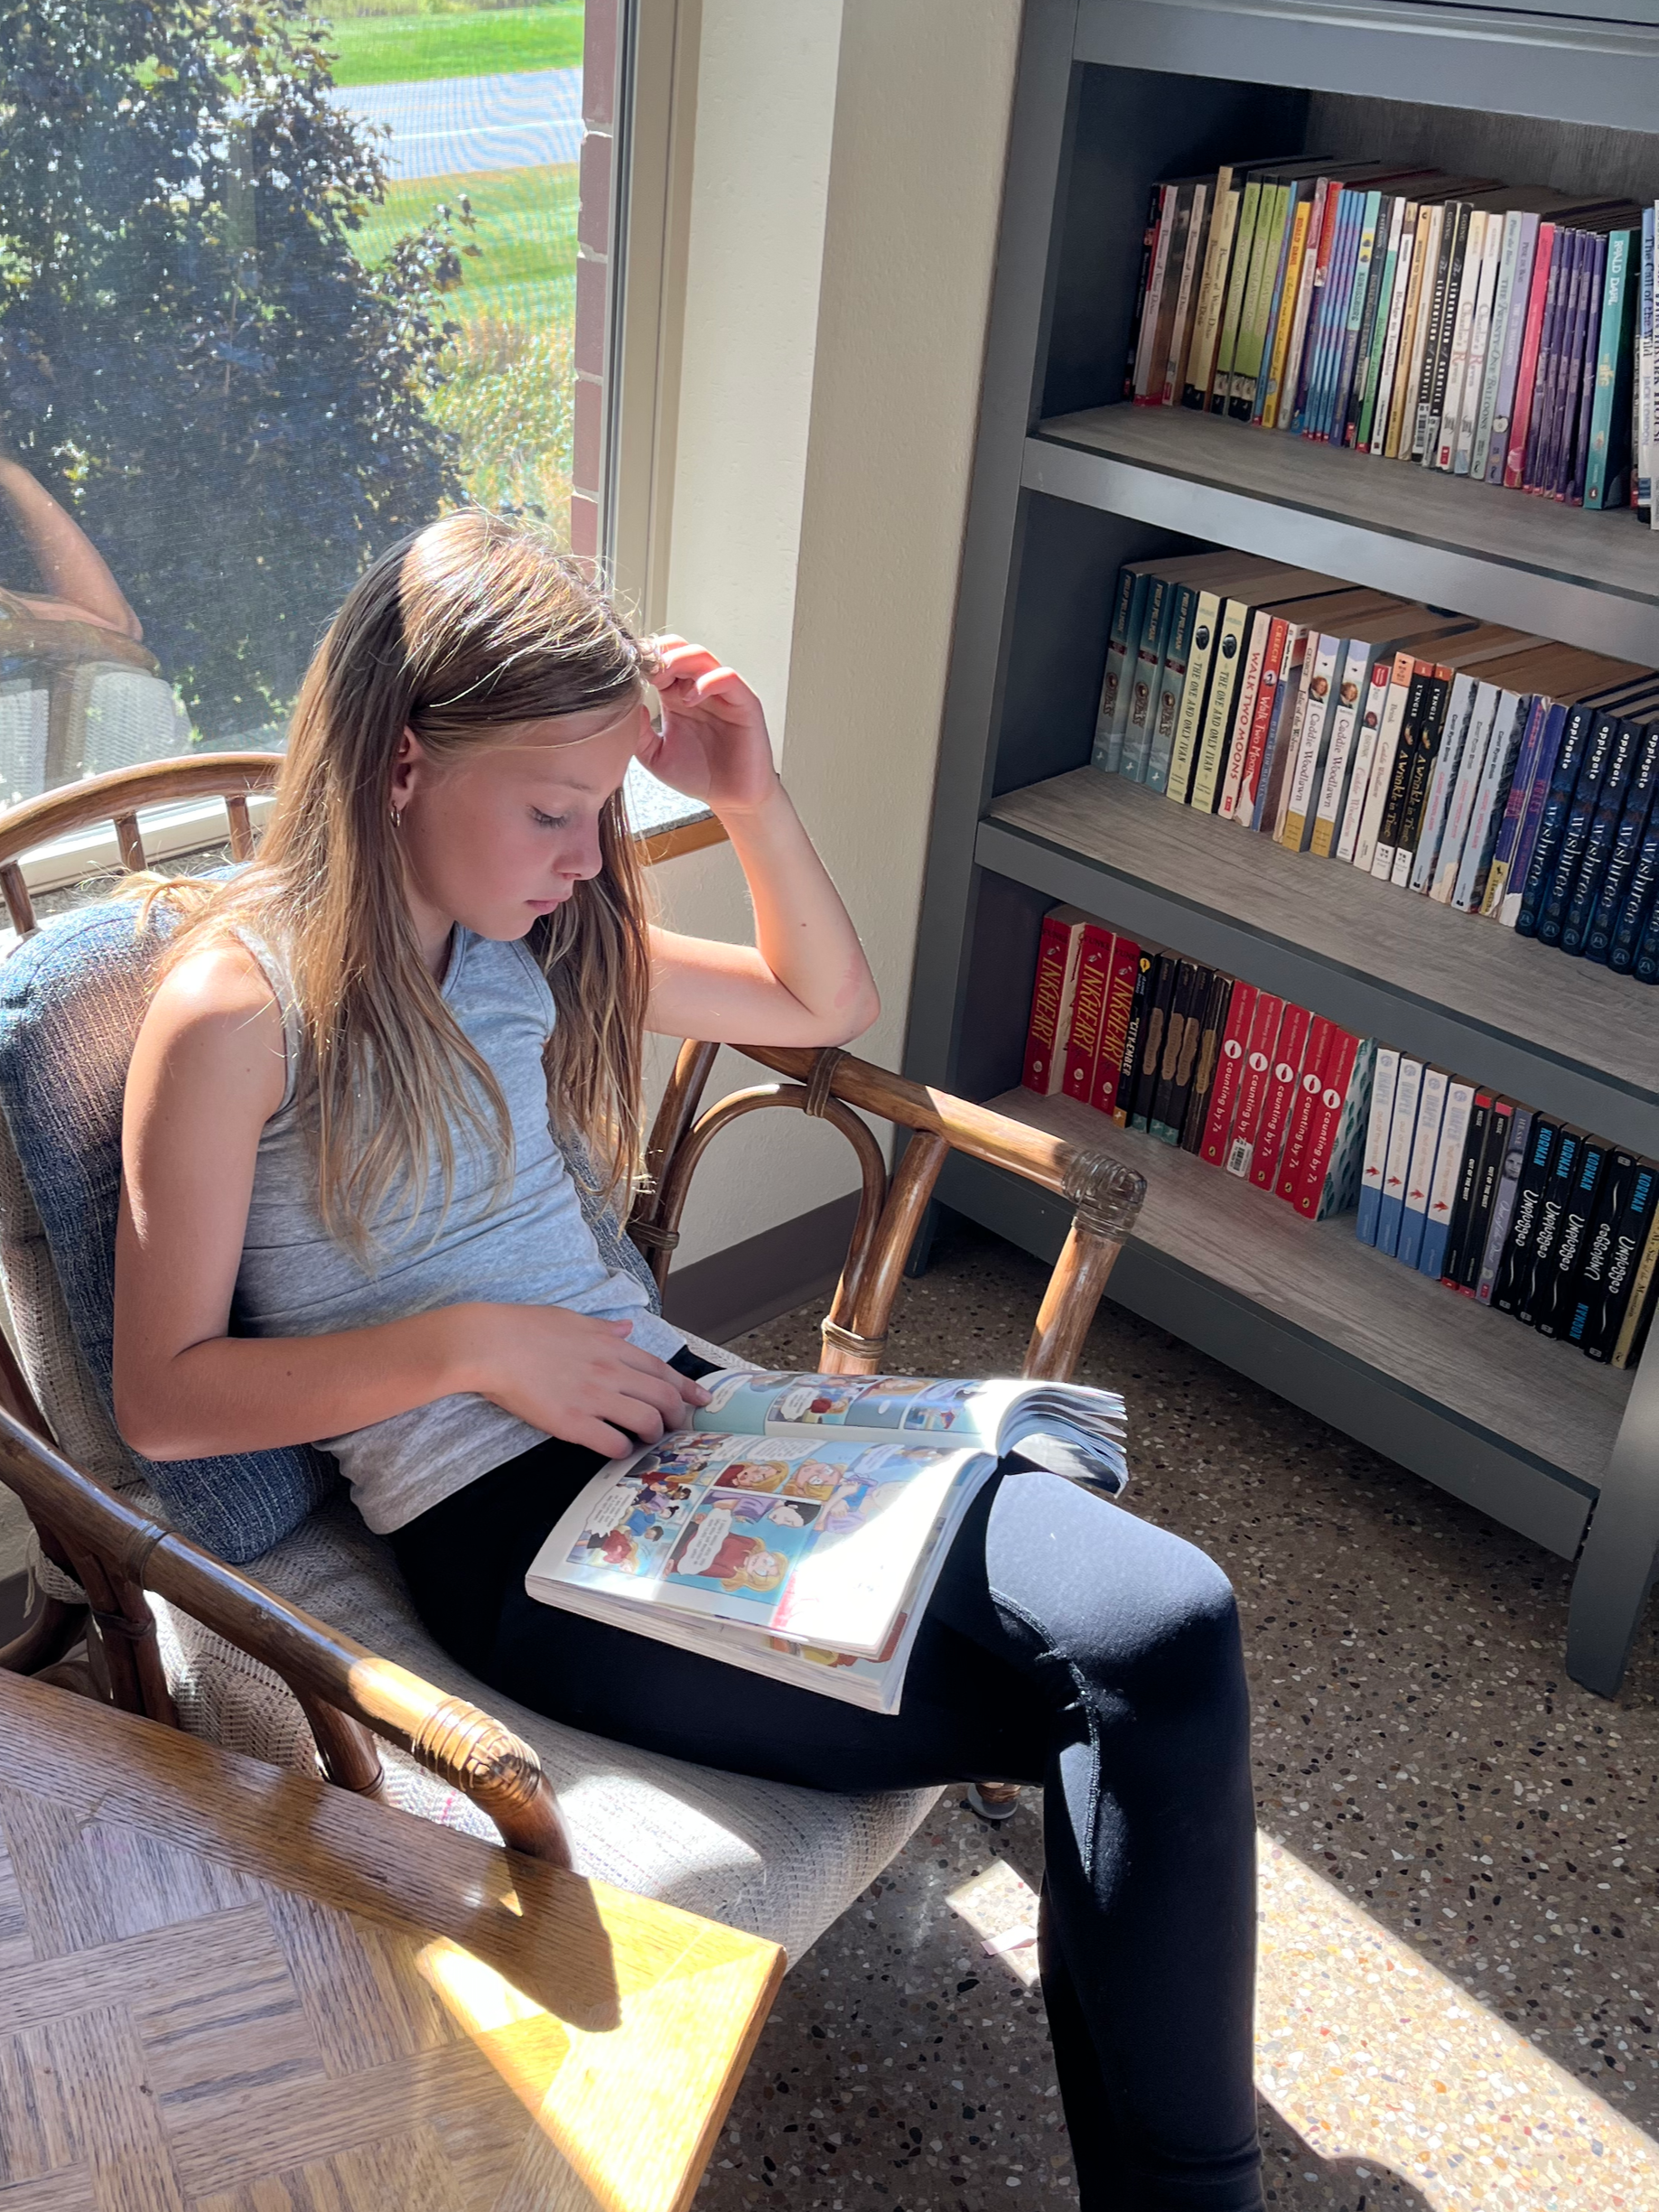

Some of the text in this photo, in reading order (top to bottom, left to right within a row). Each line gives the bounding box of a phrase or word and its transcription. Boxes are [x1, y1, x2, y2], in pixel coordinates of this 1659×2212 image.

[1289, 218, 1302, 266] ROALD DAHL
[1458, 213, 1468, 241] GOING
[1607, 239, 1623, 305] ROALD DAHL
[1391, 290, 1403, 319] Bridge
[1643, 236, 1654, 358] The Call of the Wild
[1383, 334, 1396, 376] Terabithia
[1449, 301, 1473, 385] Charlie's Raven
[1466, 303, 1488, 387] Charlie's Raven
[1479, 277, 1508, 430] THE TWENTY-ONE BALLOONS
[1597, 364, 1615, 387] BFG
[1642, 376, 1652, 445] JACK LONDON
[1174, 592, 1189, 649] PHILIP PULLMAN
[1270, 624, 1282, 662] CREECH
[1301, 648, 1313, 677] GEORGE
[1177, 661, 1202, 761] THE ONE AND ONLY IVAN
[1229, 651, 1260, 779] WALK TWO MOONS
[1296, 689, 1306, 704] Julie
[1387, 703, 1397, 723] Brink
[1410, 684, 1422, 717] L'ENGLE
[1427, 687, 1440, 721] L'ENGLE
[1202, 670, 1228, 771] THE ONE AND ONLY IVAN
[1244, 695, 1271, 776] Walk Two Moon
[1288, 728, 1300, 751] Wolves
[1292, 714, 1301, 727] the
[1294, 713, 1321, 802] Caddie Woodlawn
[1322, 718, 1349, 808] Caddie Woodlawn
[1360, 733, 1372, 758] BRINK
[1378, 742, 1390, 764] Caddie
[1399, 750, 1409, 760] A
[1416, 754, 1426, 764] A
[1561, 715, 1581, 770] applegate
[1588, 725, 1609, 779] applegate
[1608, 733, 1630, 788] applegate
[1637, 733, 1659, 789] applegate
[1342, 767, 1366, 837] Caddie Woodlawn
[1390, 760, 1408, 802] Wrinkle
[1408, 765, 1426, 807] Wrinkle
[1528, 779, 1546, 814] HOLES
[1383, 812, 1397, 838] Time
[1400, 817, 1414, 842] Time
[1526, 805, 1561, 887] wishtree
[1552, 815, 1587, 898] wishtree
[1572, 823, 1608, 905] wishtree
[1599, 825, 1636, 909] wishtree
[1623, 841, 1659, 924] wishtree
[1029, 957, 1063, 1049] INKHEART
[1069, 963, 1104, 1057] INKHEART
[1099, 976, 1135, 1070] INKHEART
[1121, 1021, 1137, 1077] CITY EMBER
[1210, 1060, 1235, 1133] counting by 7s
[1235, 1074, 1260, 1143] counting by 7
[1397, 1080, 1415, 1115] DRAPER
[1421, 1094, 1440, 1129] DRAPER
[1260, 1085, 1286, 1157] counting by 7s
[1288, 1096, 1313, 1169] counting by 7s
[1476, 1110, 1484, 1126] HESSE
[1496, 1117, 1504, 1134] HESSE
[1515, 1118, 1526, 1145] HESSE
[1305, 1110, 1333, 1183] counting by 7s
[1467, 1158, 1475, 1169] OUT
[1533, 1127, 1552, 1166] KORMAN
[1555, 1139, 1575, 1177] KORMAN
[1580, 1152, 1599, 1190] KORMAN
[1630, 1172, 1651, 1212] KORMAN
[1461, 1186, 1469, 1200] DUST
[1480, 1194, 1488, 1208] DUST
[1496, 1199, 1510, 1218] Out
[1645, 1248, 1655, 1264] Side
[1569, 1302, 1589, 1339] KORMAN
[1626, 1283, 1645, 1318] Mountain
